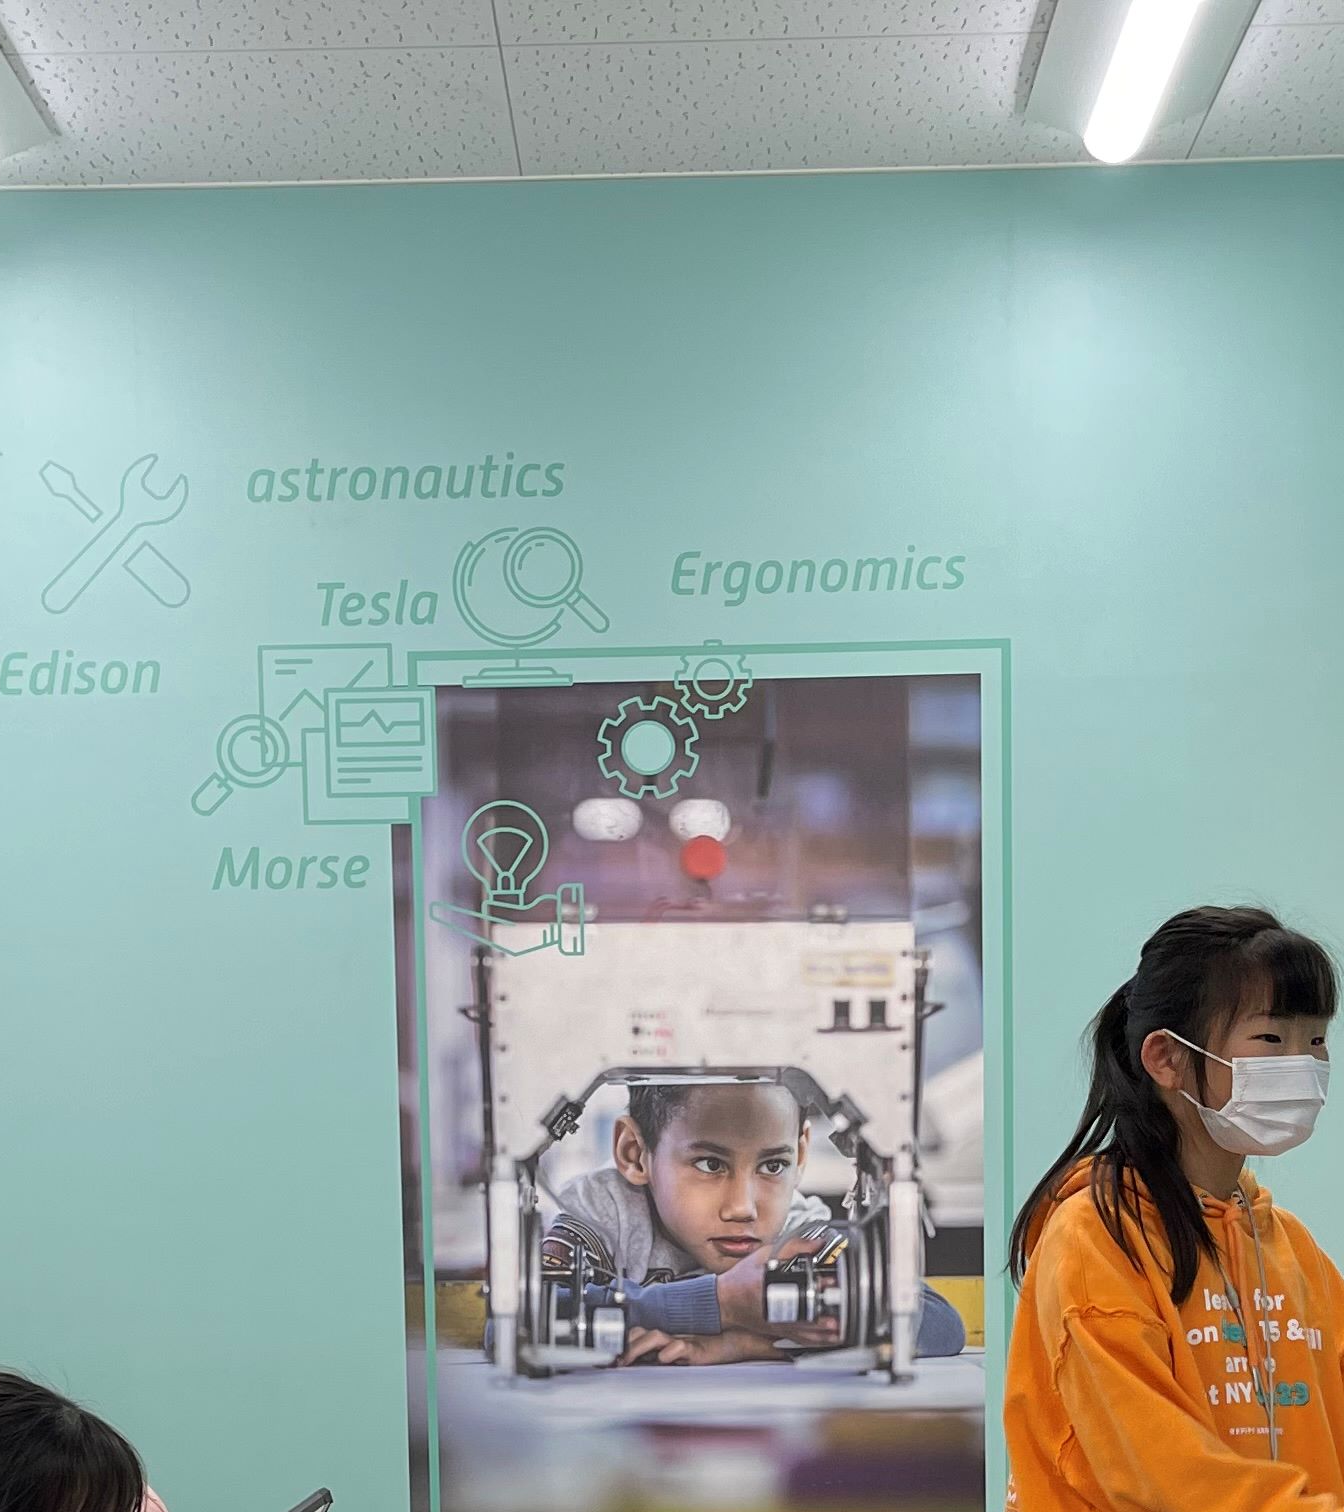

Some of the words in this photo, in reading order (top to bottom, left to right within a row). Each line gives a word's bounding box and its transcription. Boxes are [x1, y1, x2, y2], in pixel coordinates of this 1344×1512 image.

[246, 452, 566, 503] astronautics
[671, 545, 966, 606] Ergonomics
[317, 579, 439, 627] Tesla
[212, 847, 371, 891] Morse
